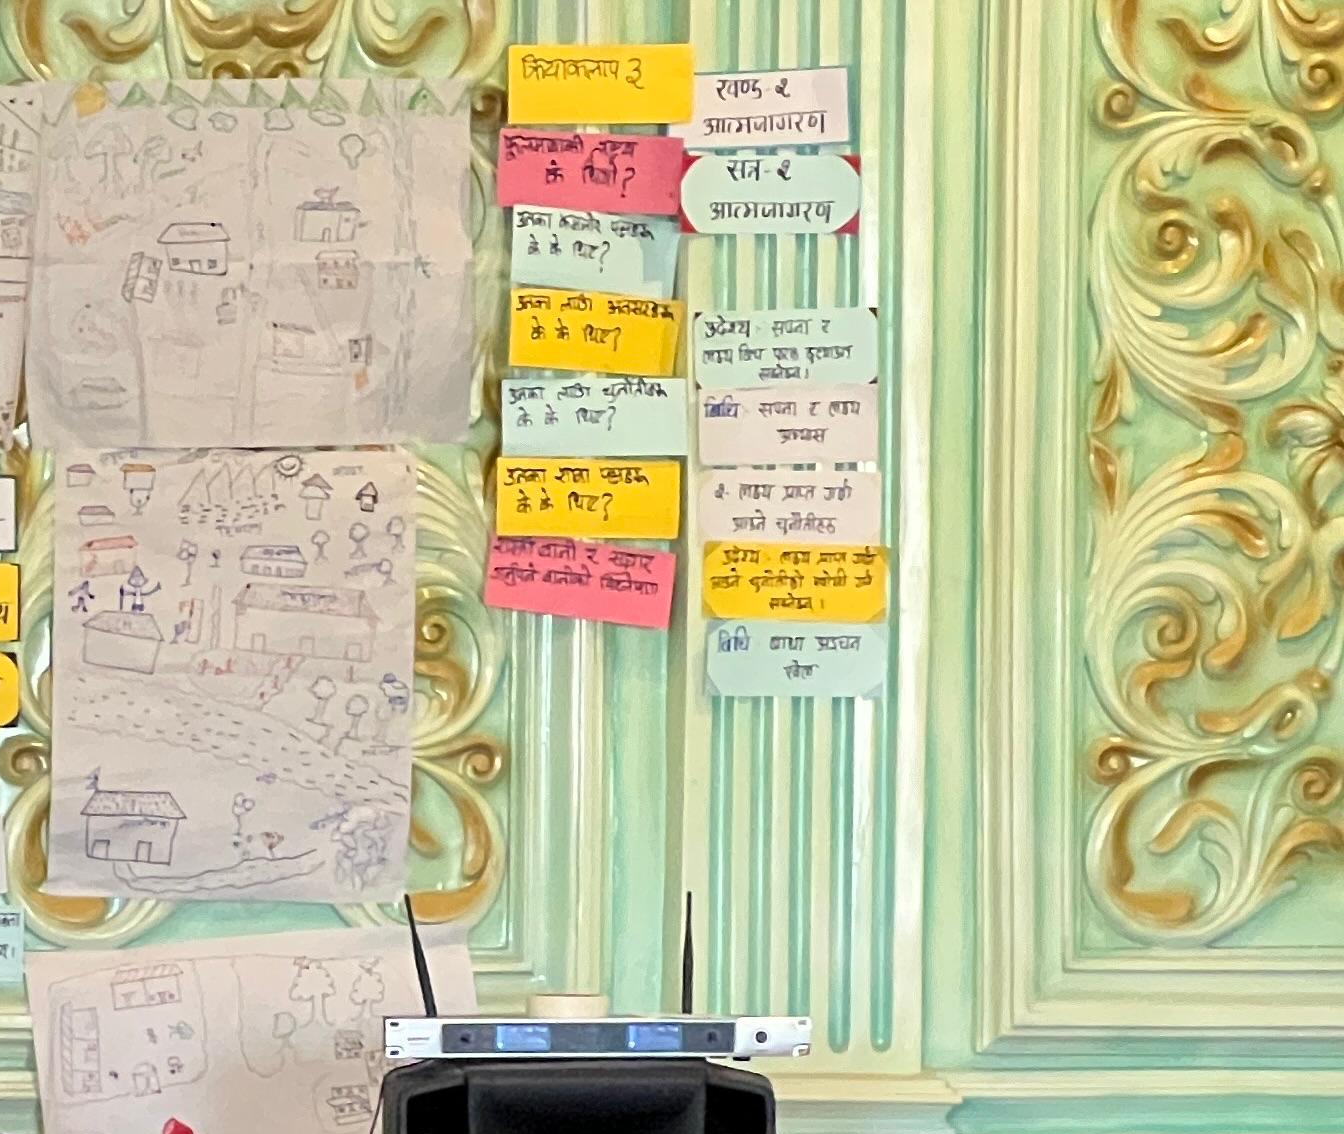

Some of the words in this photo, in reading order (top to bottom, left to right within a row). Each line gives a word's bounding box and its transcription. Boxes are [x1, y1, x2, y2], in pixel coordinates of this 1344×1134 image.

[703, 110, 827, 136] आत्मजागरण
[710, 201, 835, 224] आत्मजागरण
[821, 319, 831, 333] र
[809, 401, 822, 416] र
[586, 549, 599, 566] र
